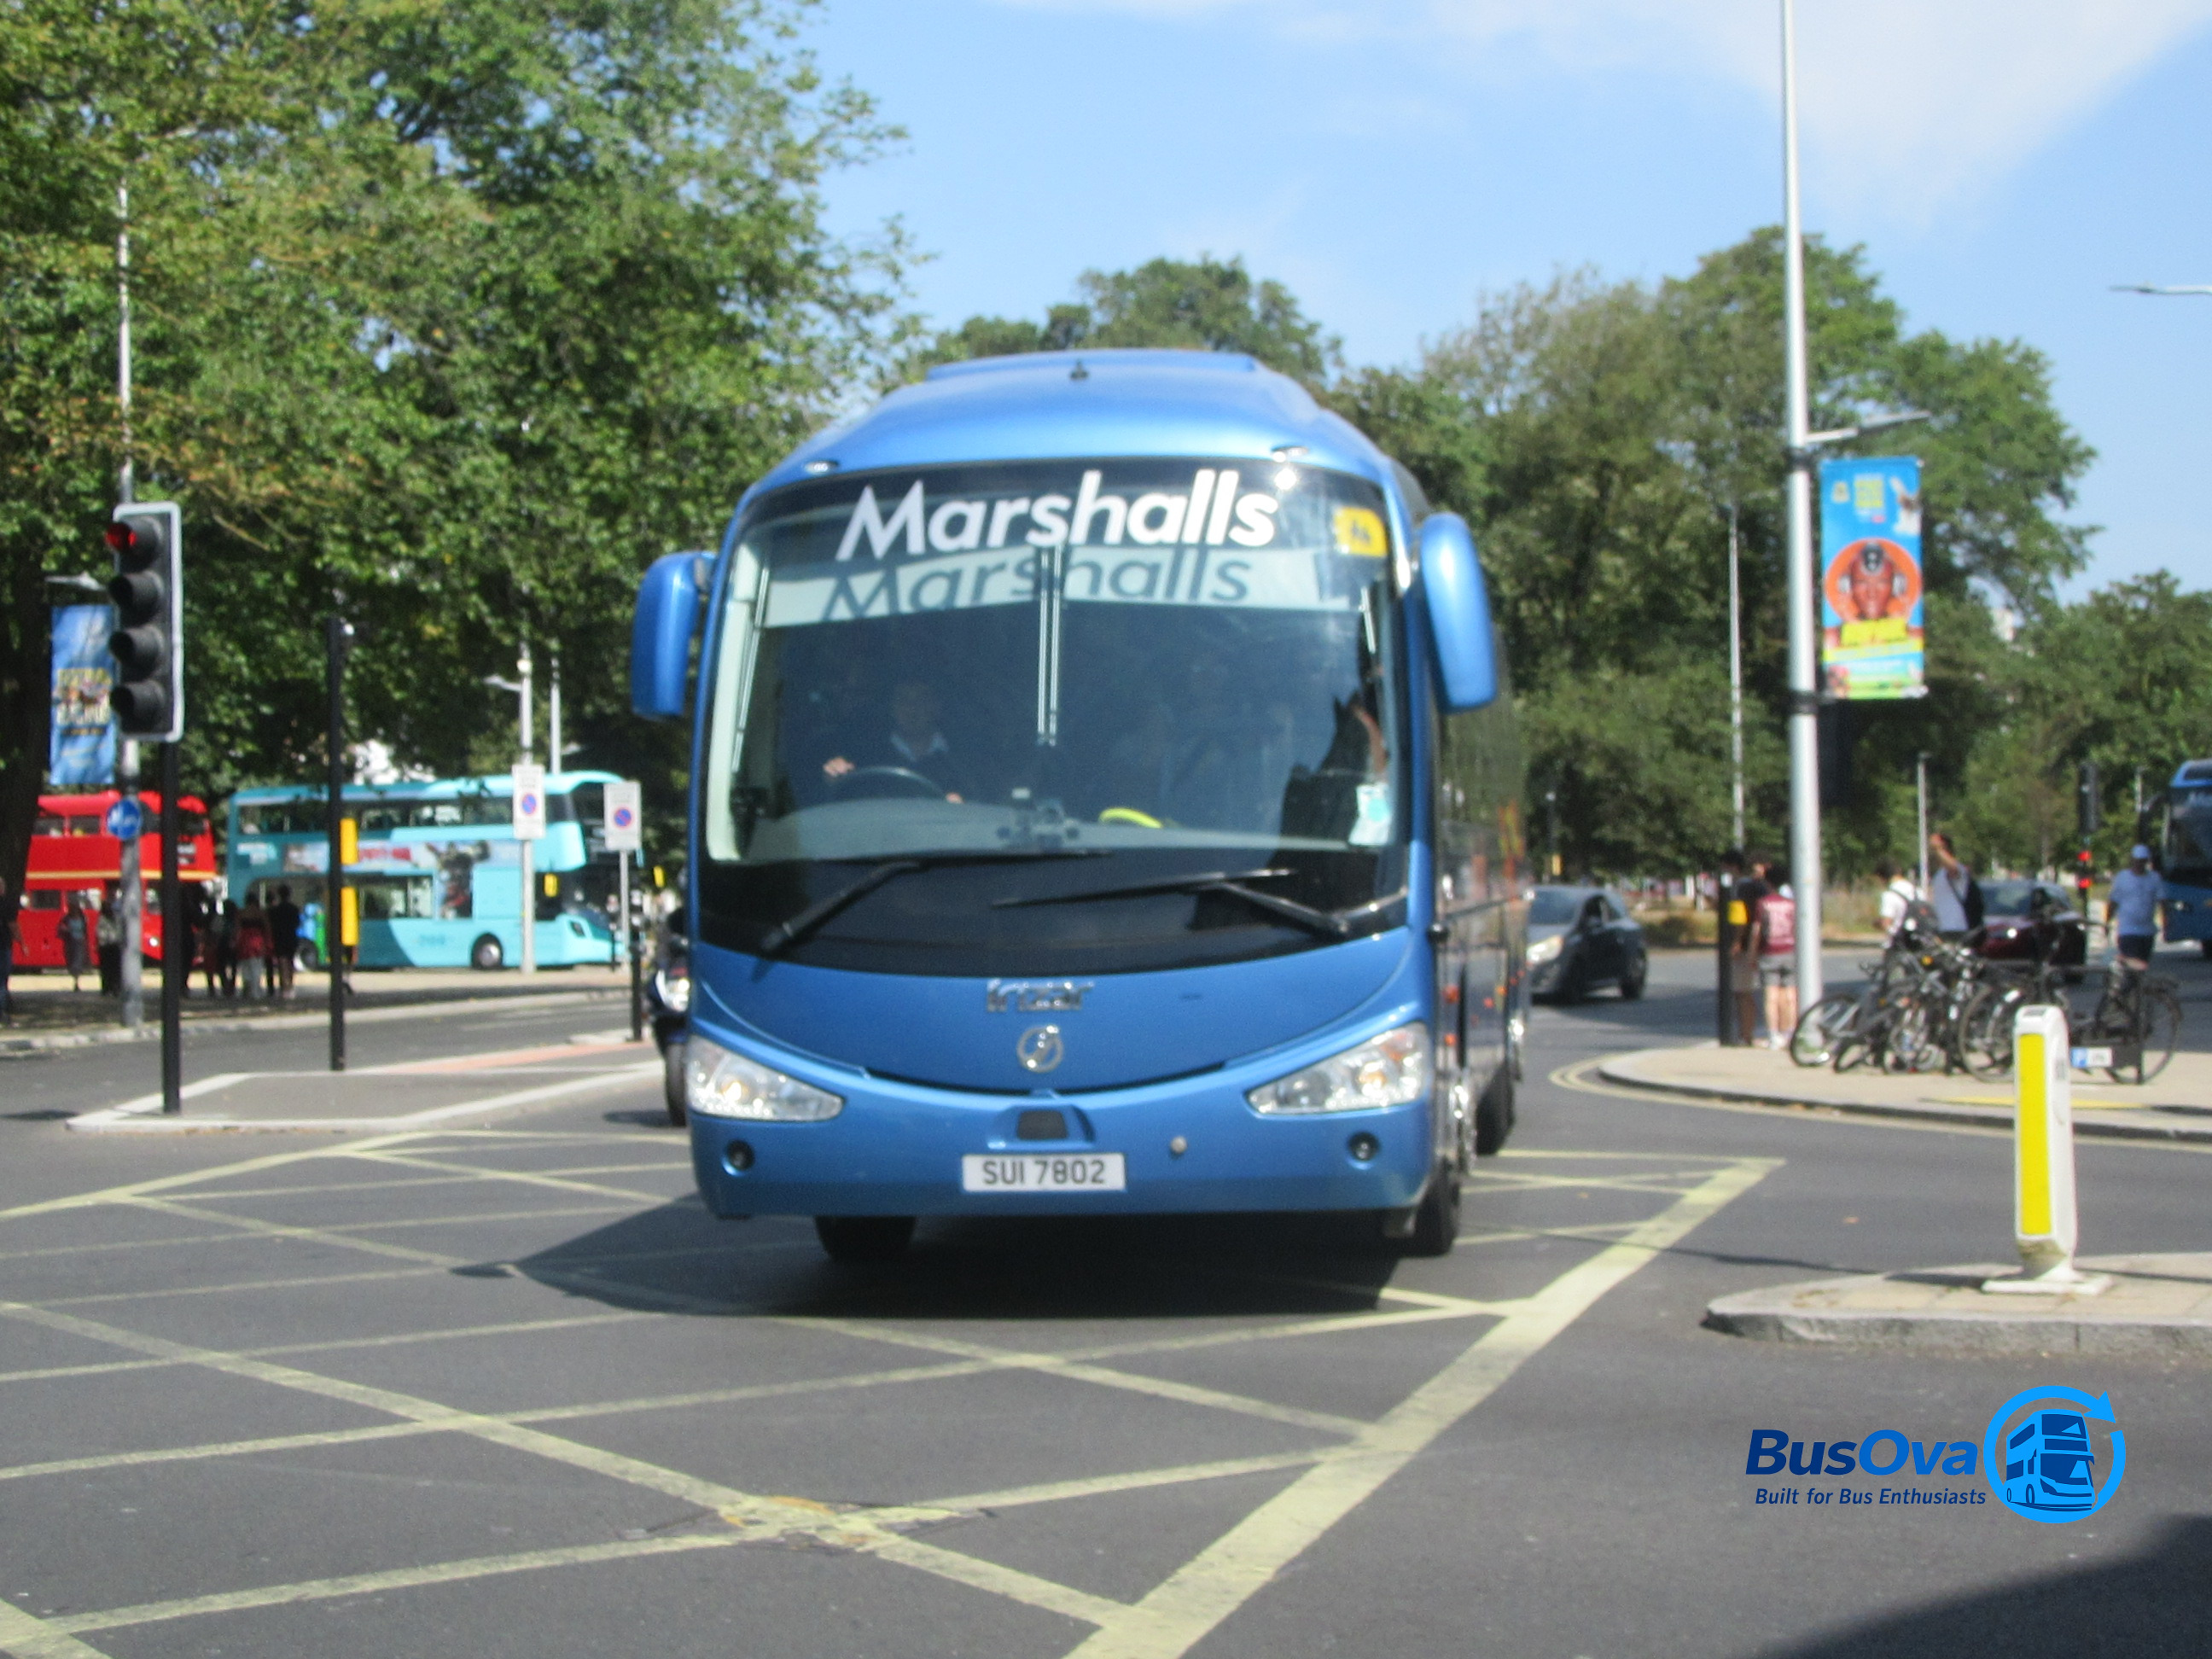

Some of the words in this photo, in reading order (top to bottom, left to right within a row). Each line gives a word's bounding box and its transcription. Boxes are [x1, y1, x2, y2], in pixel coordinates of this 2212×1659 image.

[836, 469, 1278, 562] Marshalls
[981, 1160, 1026, 1185] SUI
[1033, 1160, 1105, 1185] 7802
